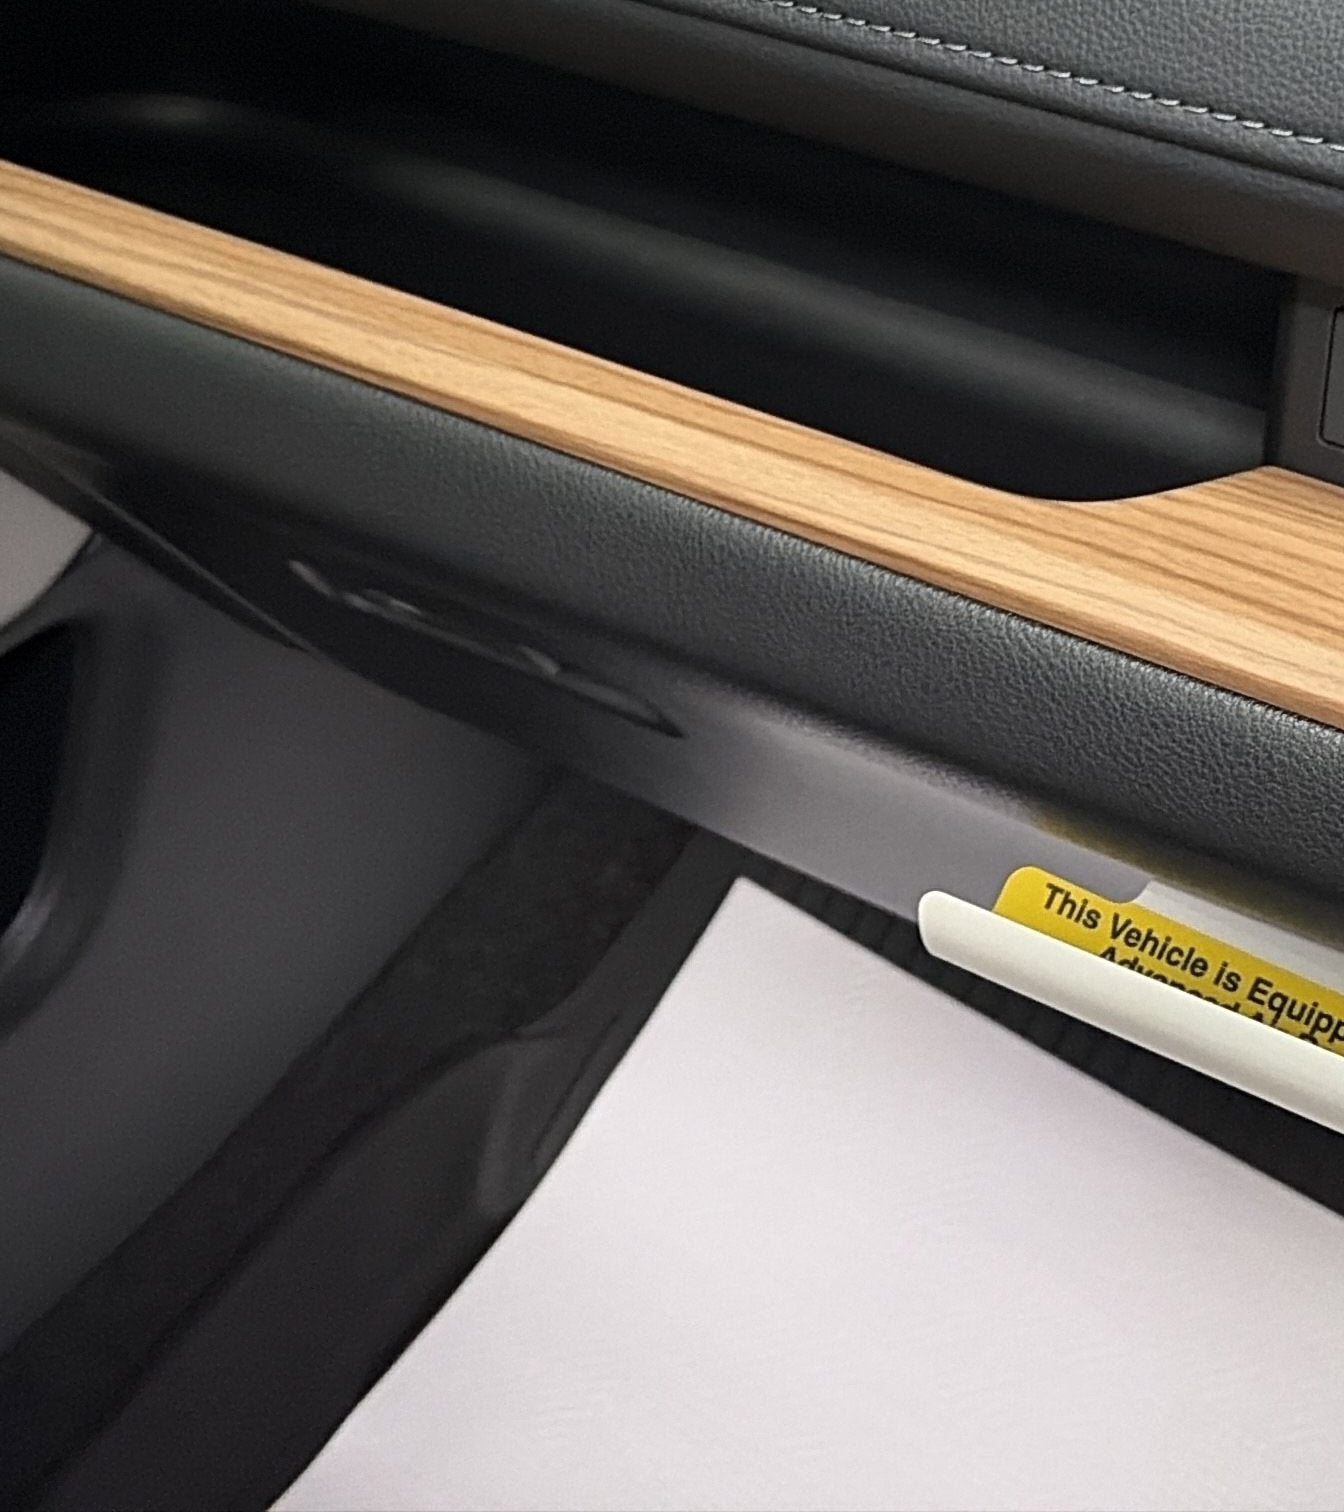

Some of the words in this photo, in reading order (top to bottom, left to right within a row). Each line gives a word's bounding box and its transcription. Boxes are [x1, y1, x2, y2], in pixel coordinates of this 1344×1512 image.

[1044, 882, 1102, 930] This
[1110, 912, 1209, 978] Vehicle
[1213, 961, 1242, 992] is
